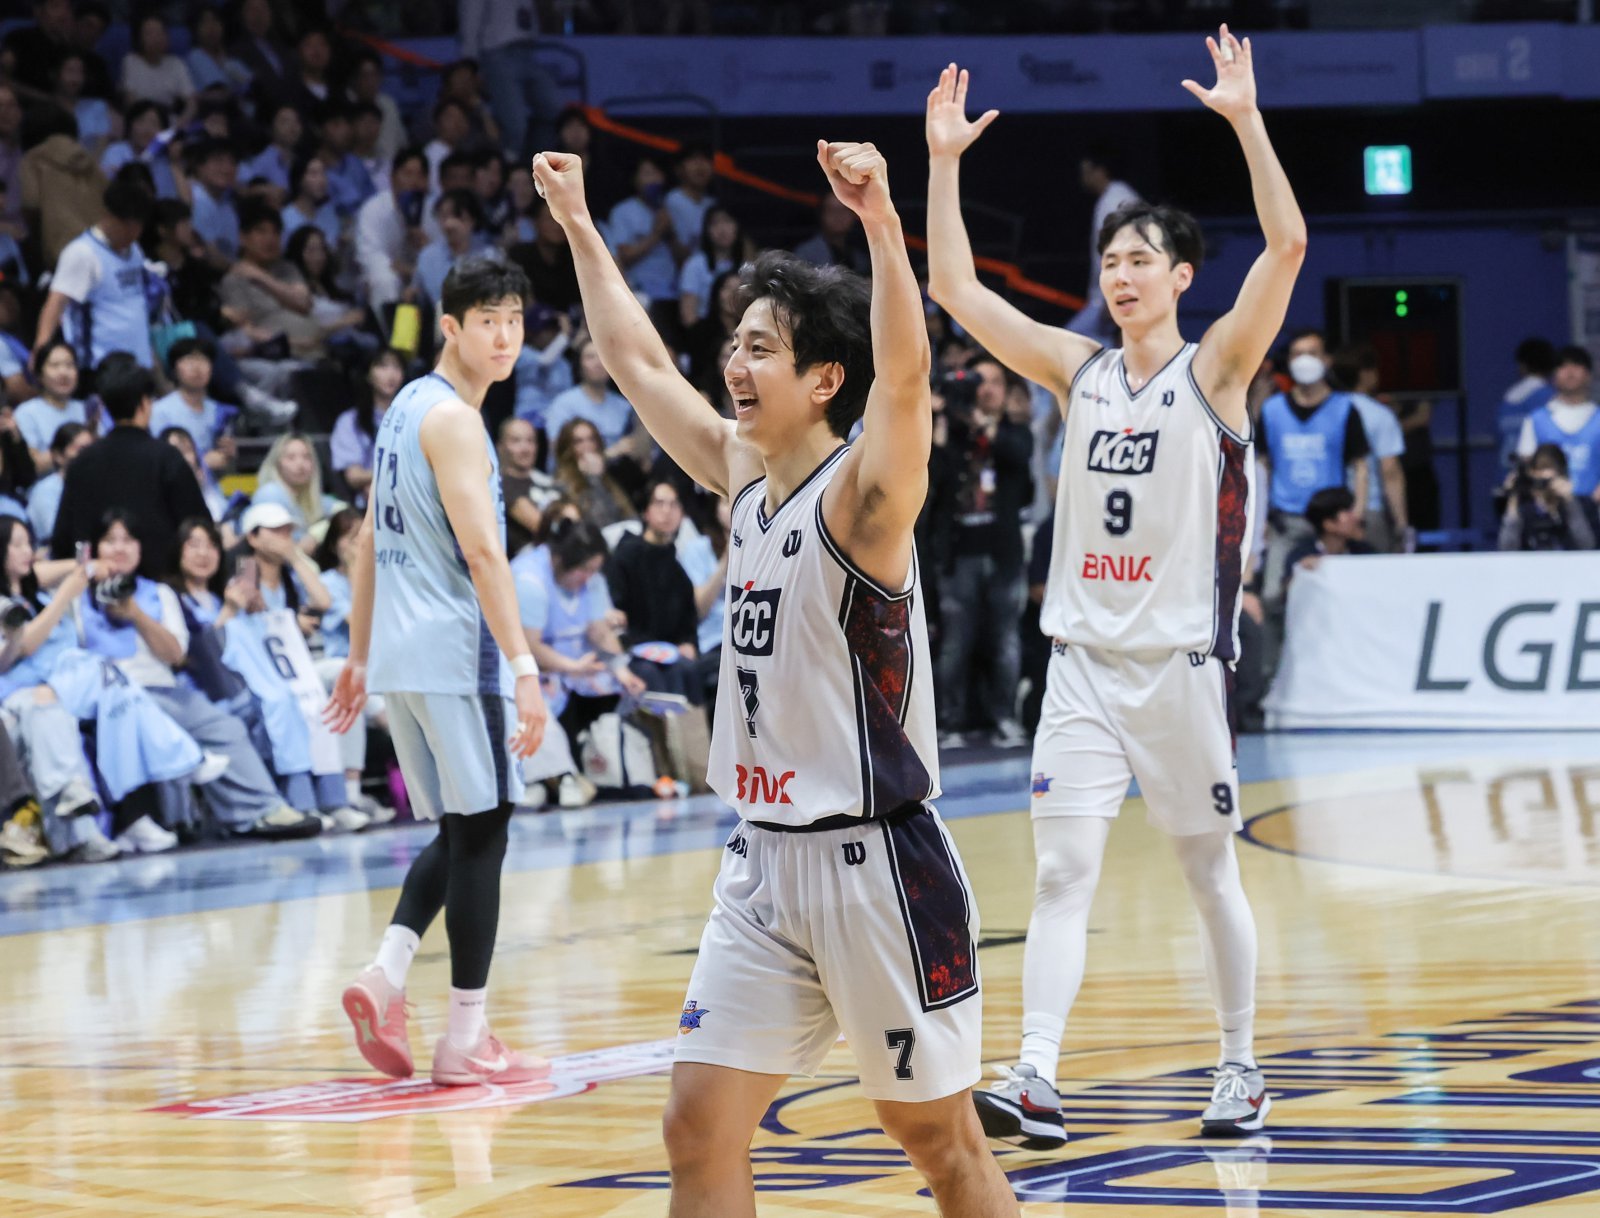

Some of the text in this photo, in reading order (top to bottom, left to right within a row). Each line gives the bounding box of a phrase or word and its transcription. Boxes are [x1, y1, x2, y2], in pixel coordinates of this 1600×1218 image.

[1089, 429, 1153, 473] KCC
[1105, 488, 1133, 537] 9
[1082, 553, 1154, 582] BNK
[263, 635, 297, 680] 6
[1211, 782, 1234, 816] 9
[884, 1027, 915, 1081] 7
